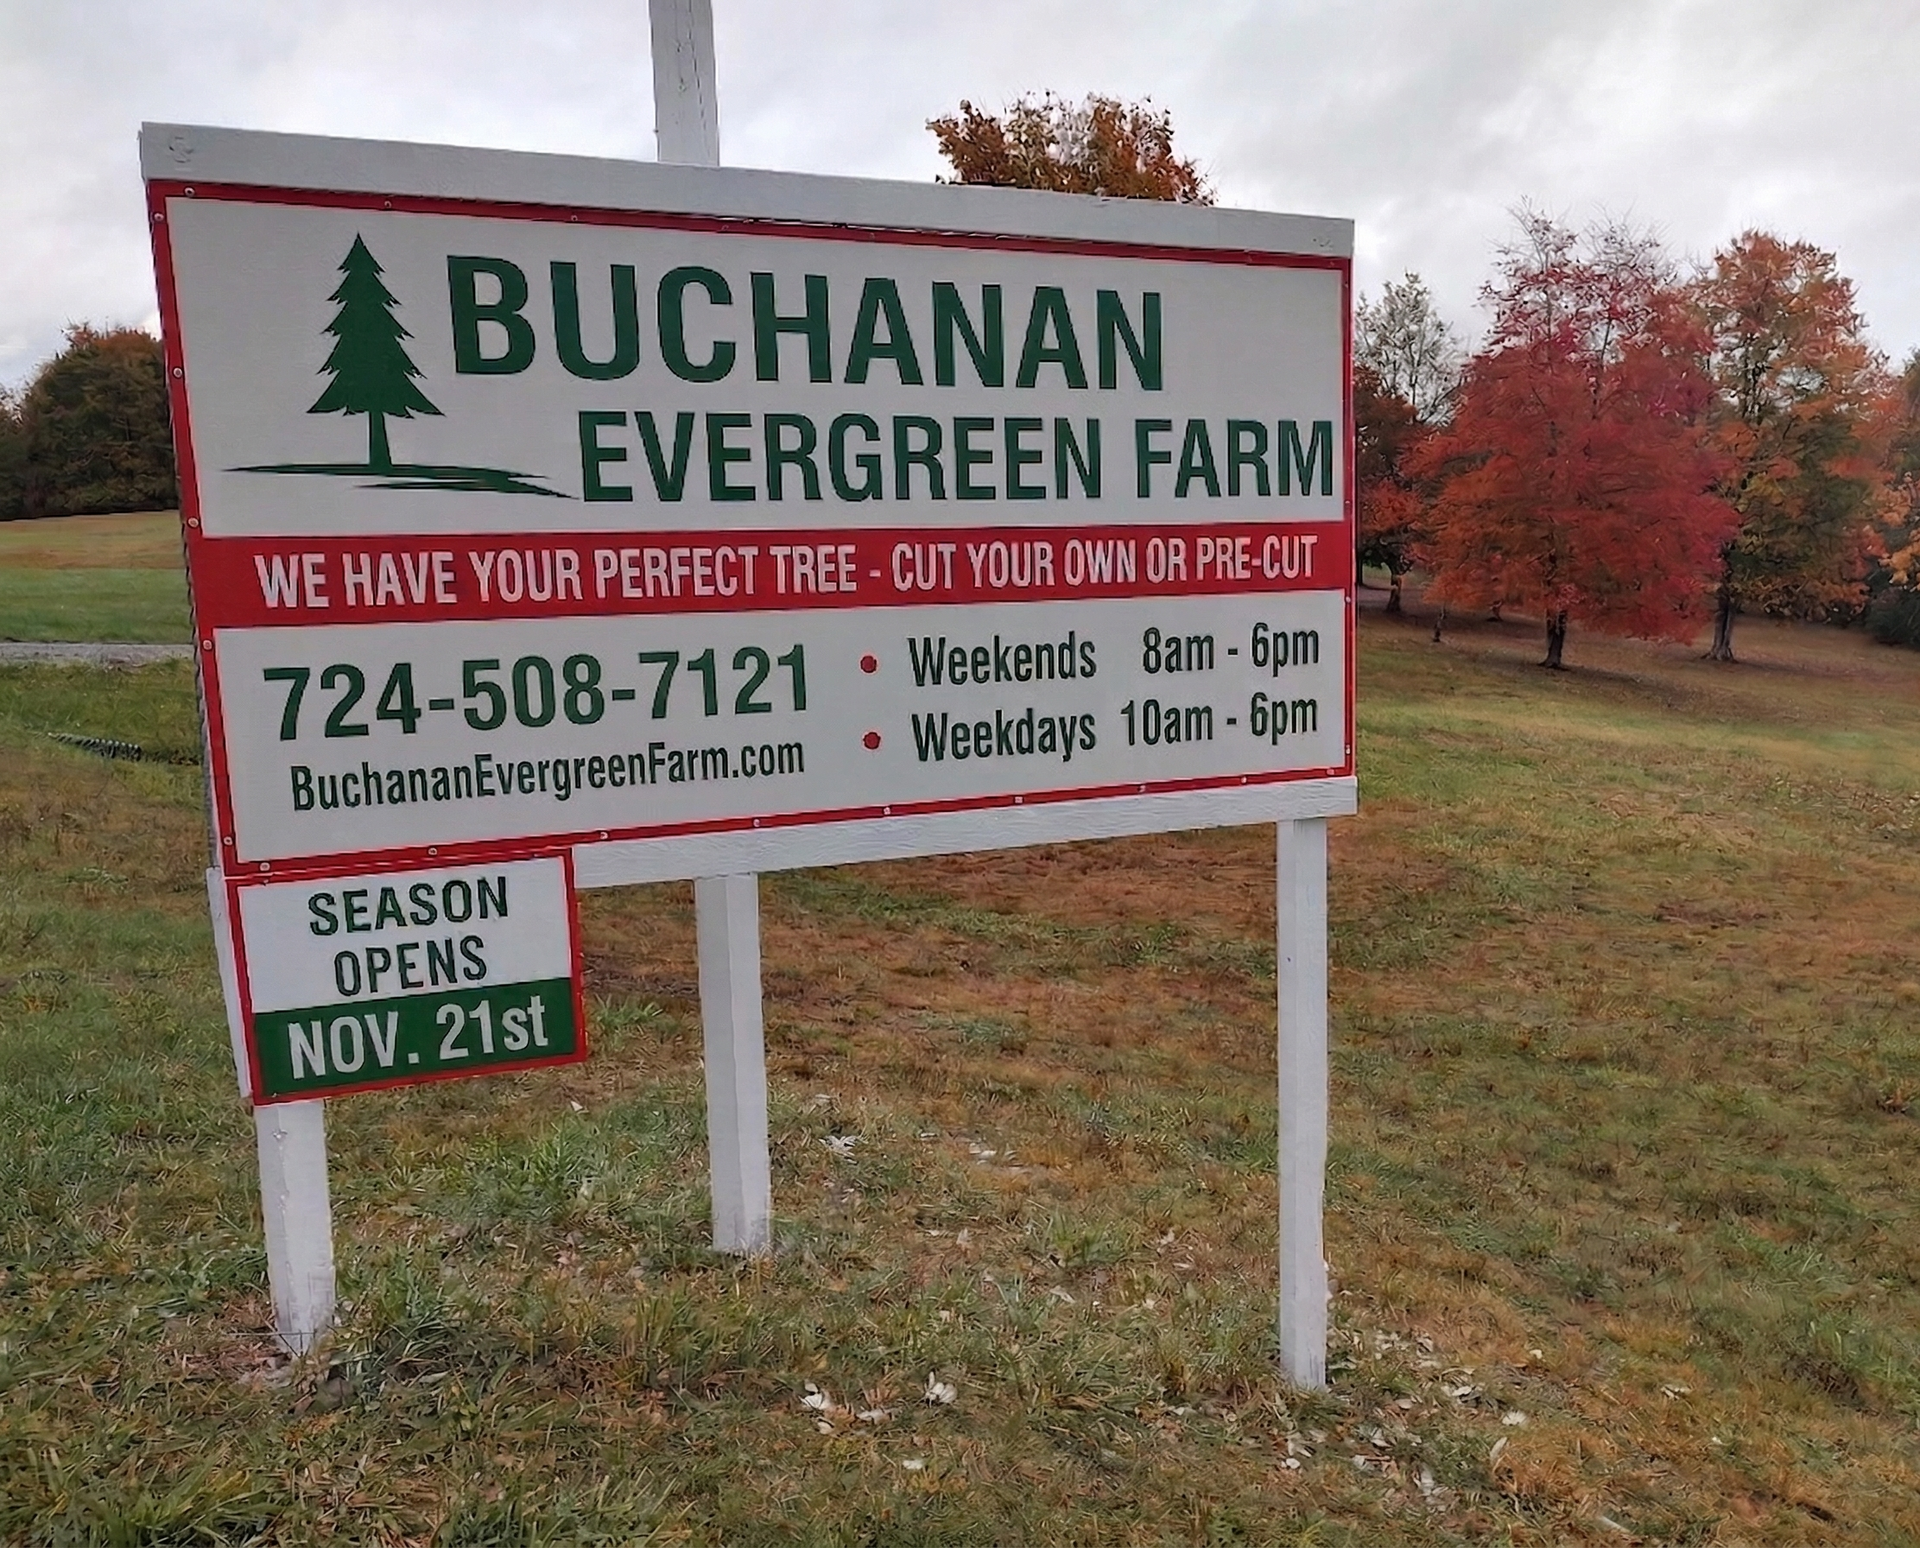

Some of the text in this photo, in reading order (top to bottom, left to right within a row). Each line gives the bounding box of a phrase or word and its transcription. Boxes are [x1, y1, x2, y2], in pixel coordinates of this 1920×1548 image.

[447, 255, 1163, 391] BUCHANAN
[578, 411, 1333, 502] EVERGREEN FARM
[254, 535, 1319, 608] WE HAVE YOUR PERFECT TREE - CUT YOUR OWN OR PRE-CUT
[908, 622, 1319, 686] Weekends 8am - 6pm
[262, 644, 808, 741] 724-508-7121
[911, 692, 1318, 762] Weekdays 10am - 6pm
[291, 740, 805, 811] BuchananEvergreenFarm.com
[309, 876, 508, 936] SEASON
[334, 934, 488, 997] OPENS
[287, 995, 549, 1079] NOV. 21st
